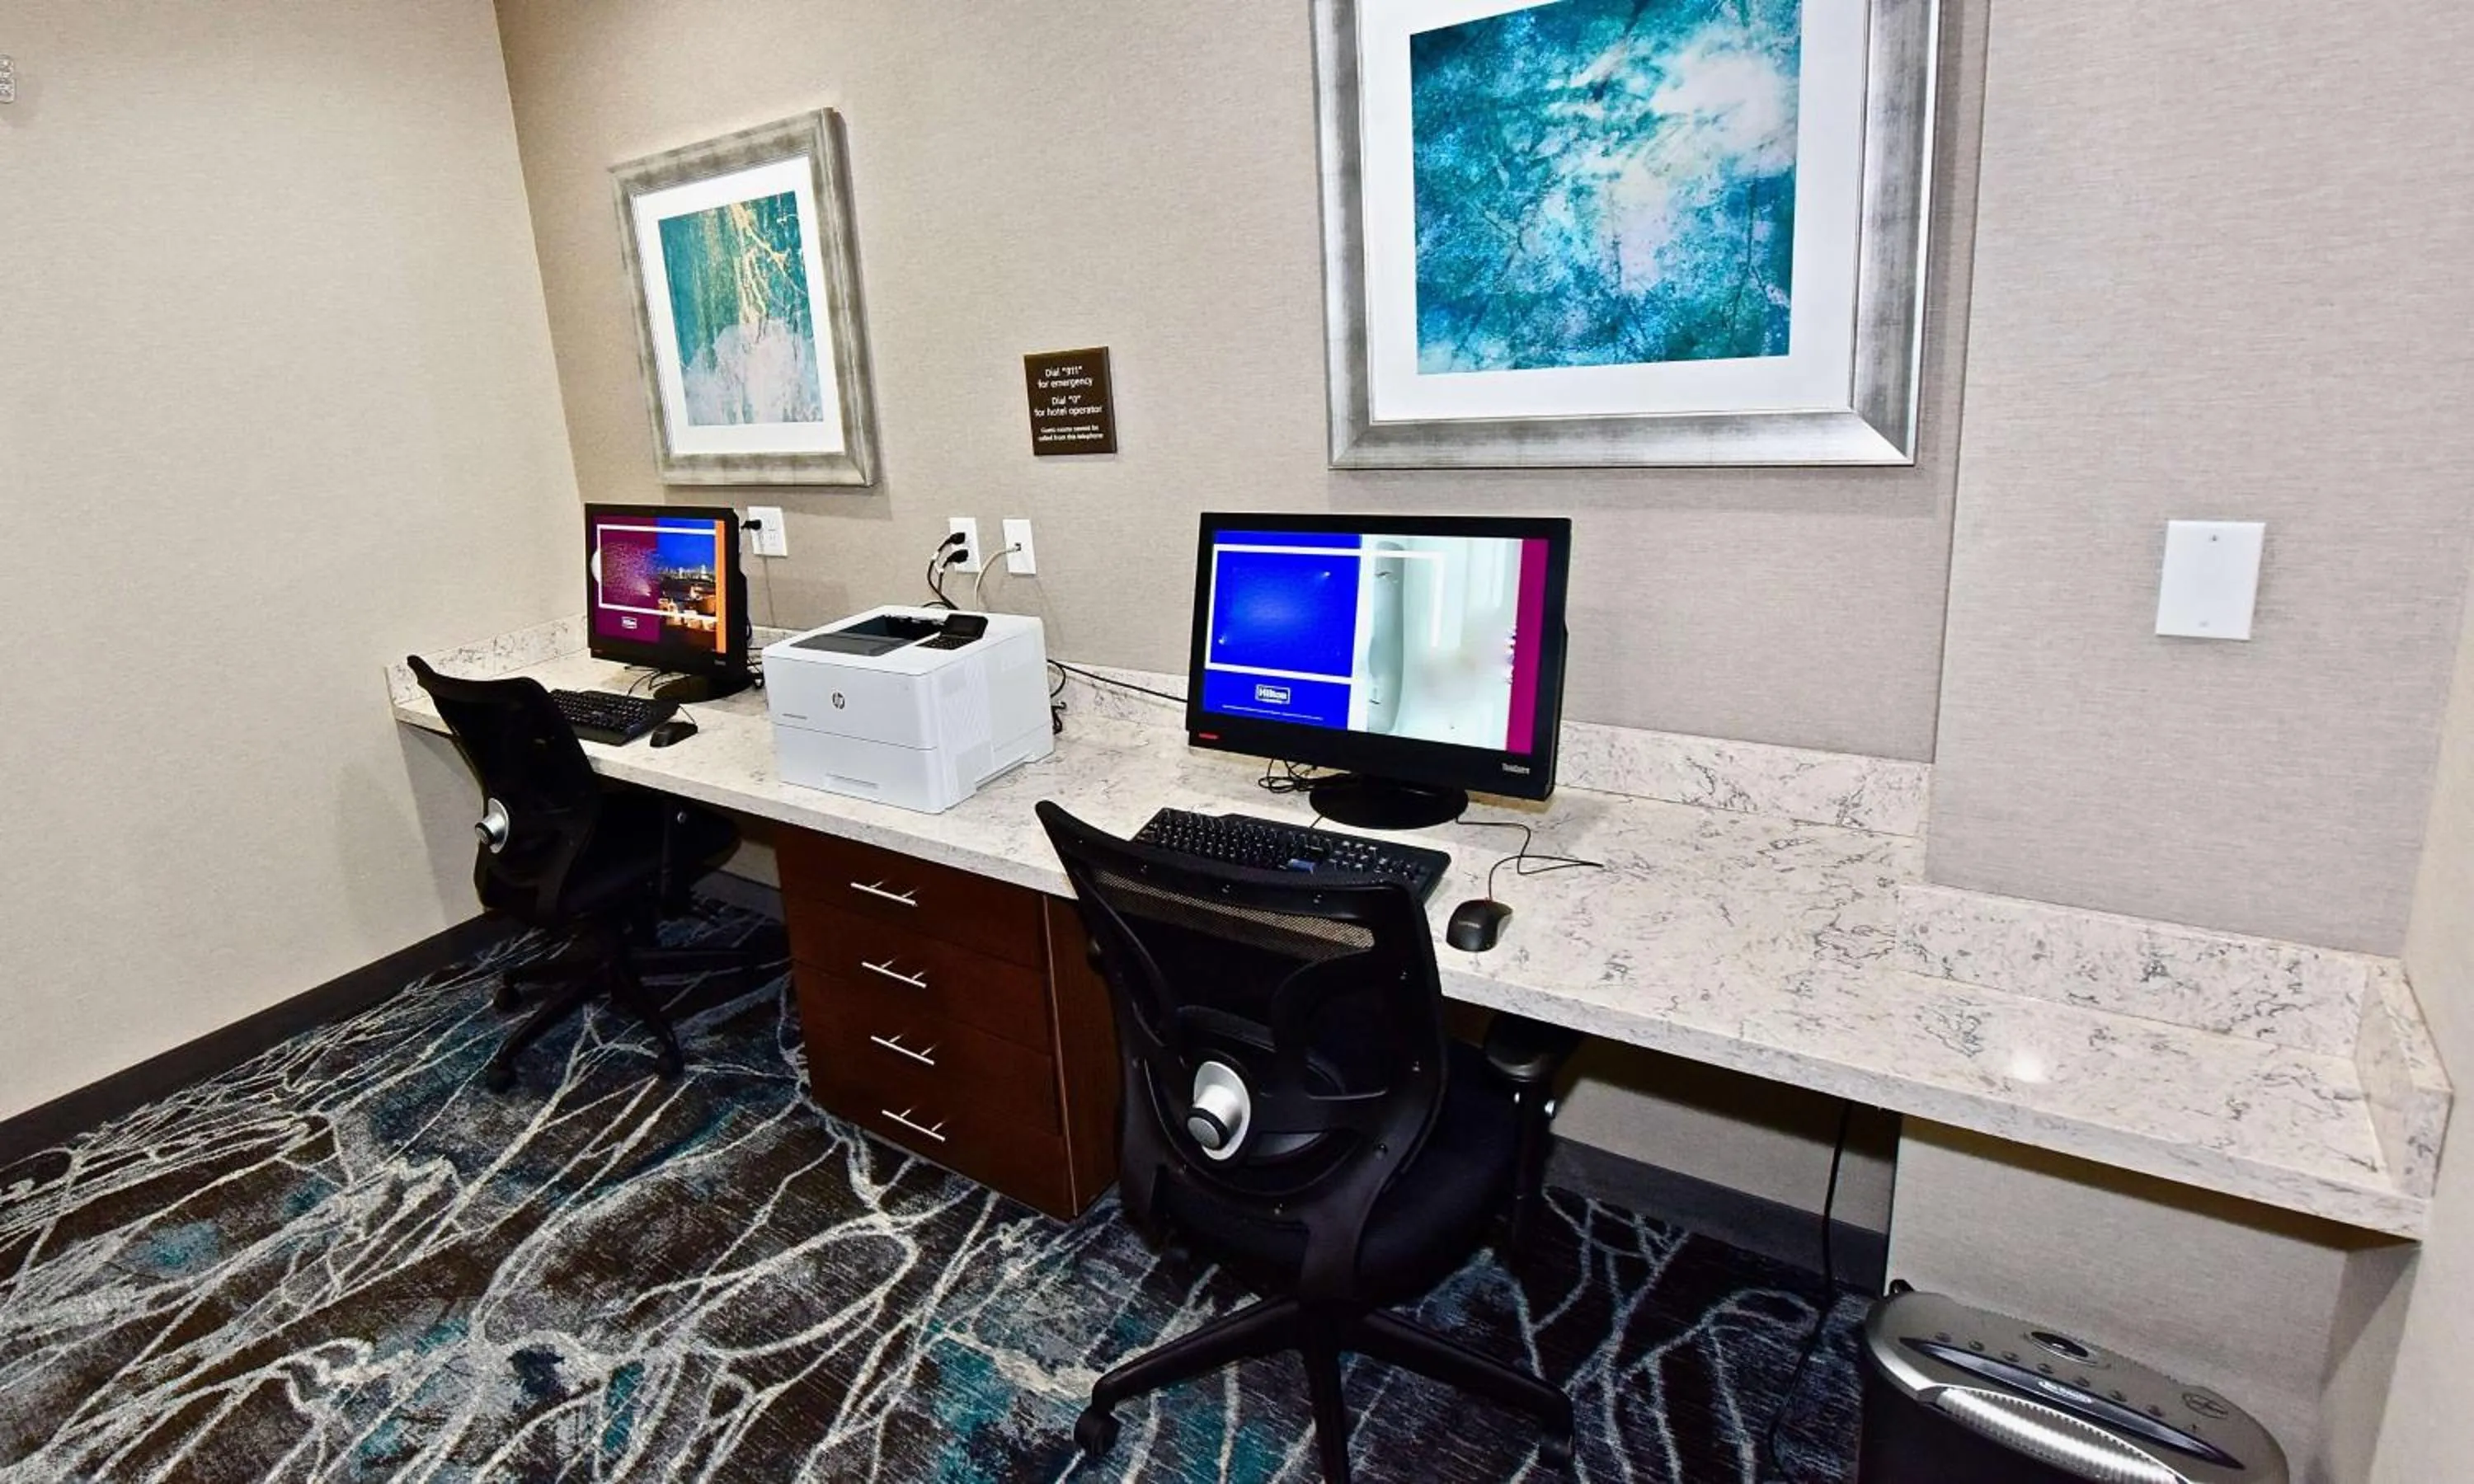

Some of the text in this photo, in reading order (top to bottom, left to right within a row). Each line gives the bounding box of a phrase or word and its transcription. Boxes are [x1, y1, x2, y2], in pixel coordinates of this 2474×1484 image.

[1045, 367, 1060, 378] Dial
[1037, 378, 1093, 389] for emergency
[1051, 396, 1066, 406] Dial
[1034, 406, 1103, 416] for hotel operator
